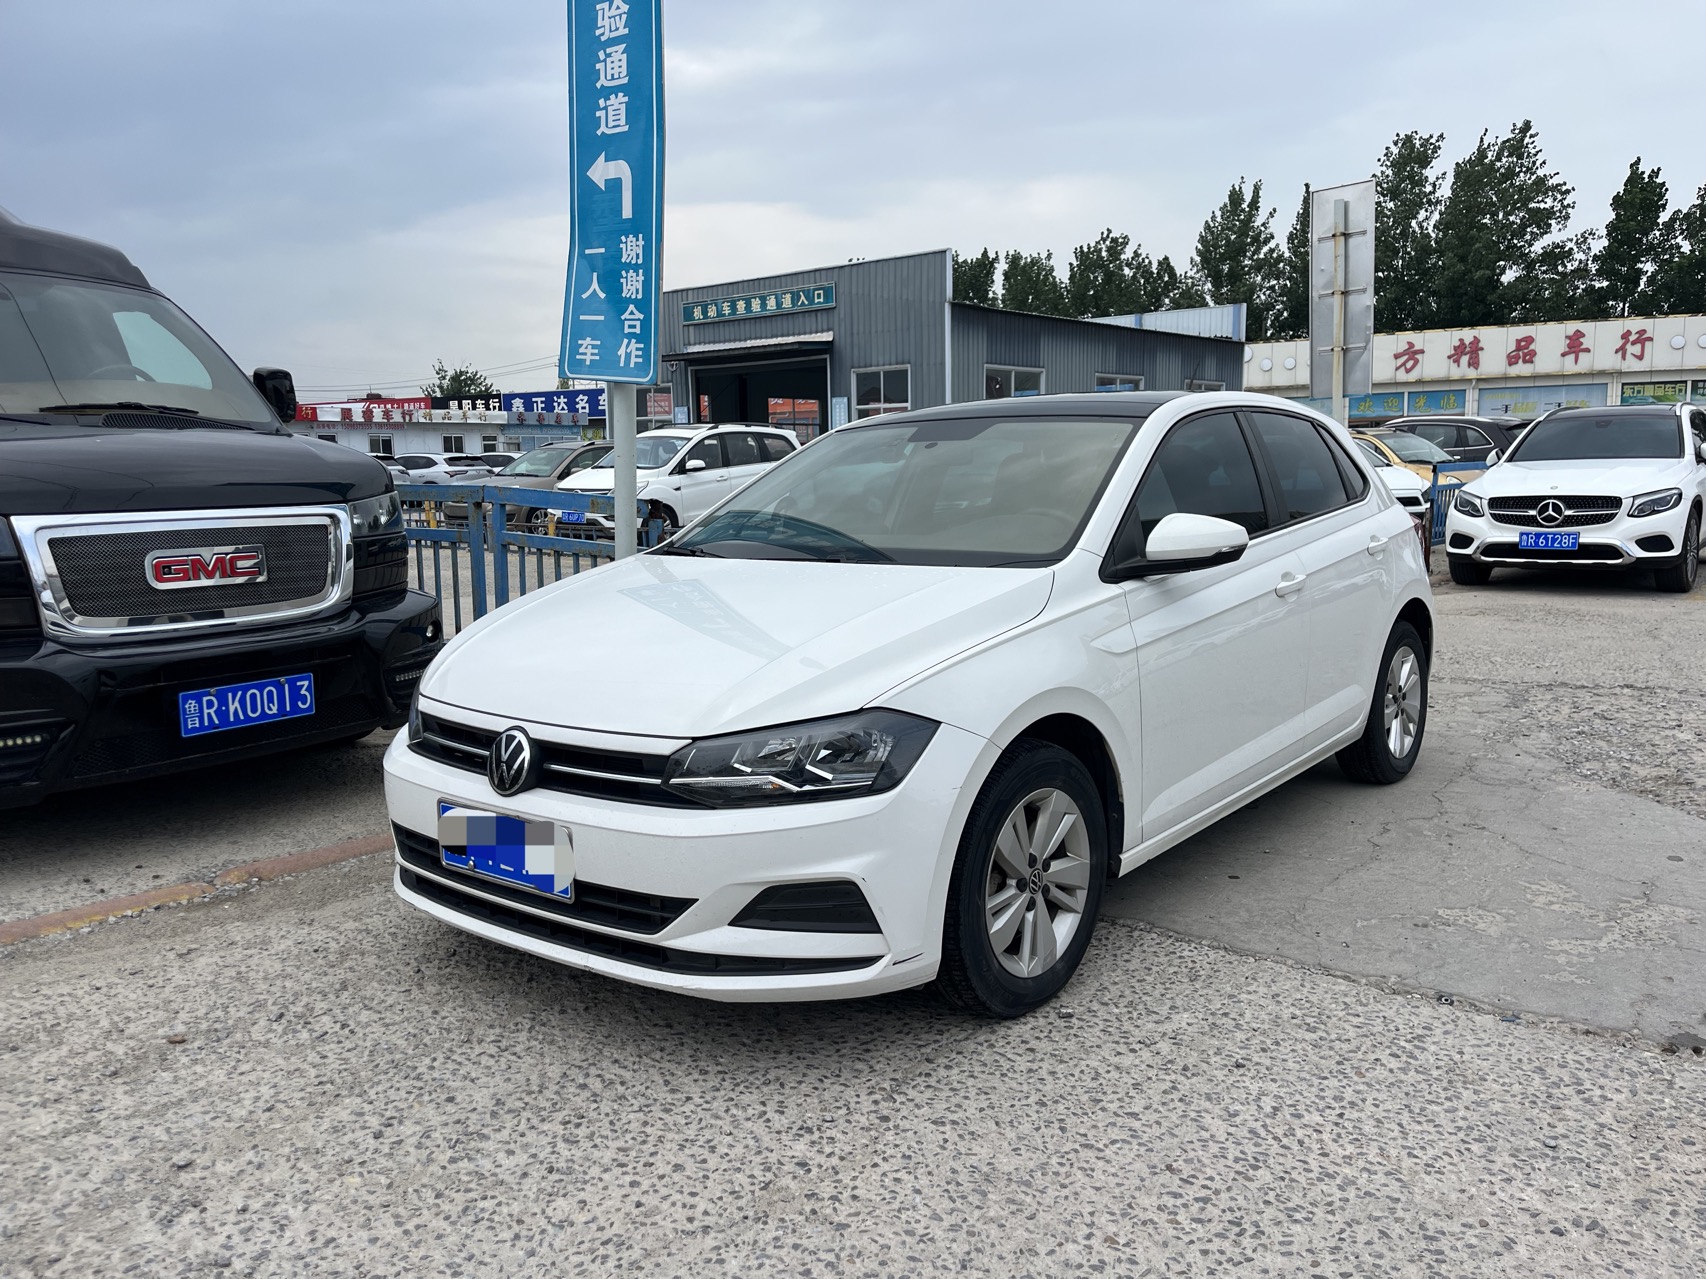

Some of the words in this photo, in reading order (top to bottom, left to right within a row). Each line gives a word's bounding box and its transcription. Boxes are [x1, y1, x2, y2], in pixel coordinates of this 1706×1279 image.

[576, 247, 607, 366] 一人一车
[617, 234, 645, 367] 谢谢合作
[693, 290, 824, 320] 机动车查验通道入口
[1357, 393, 1459, 413] 欢迎光临
[152, 551, 261, 583] GMC
